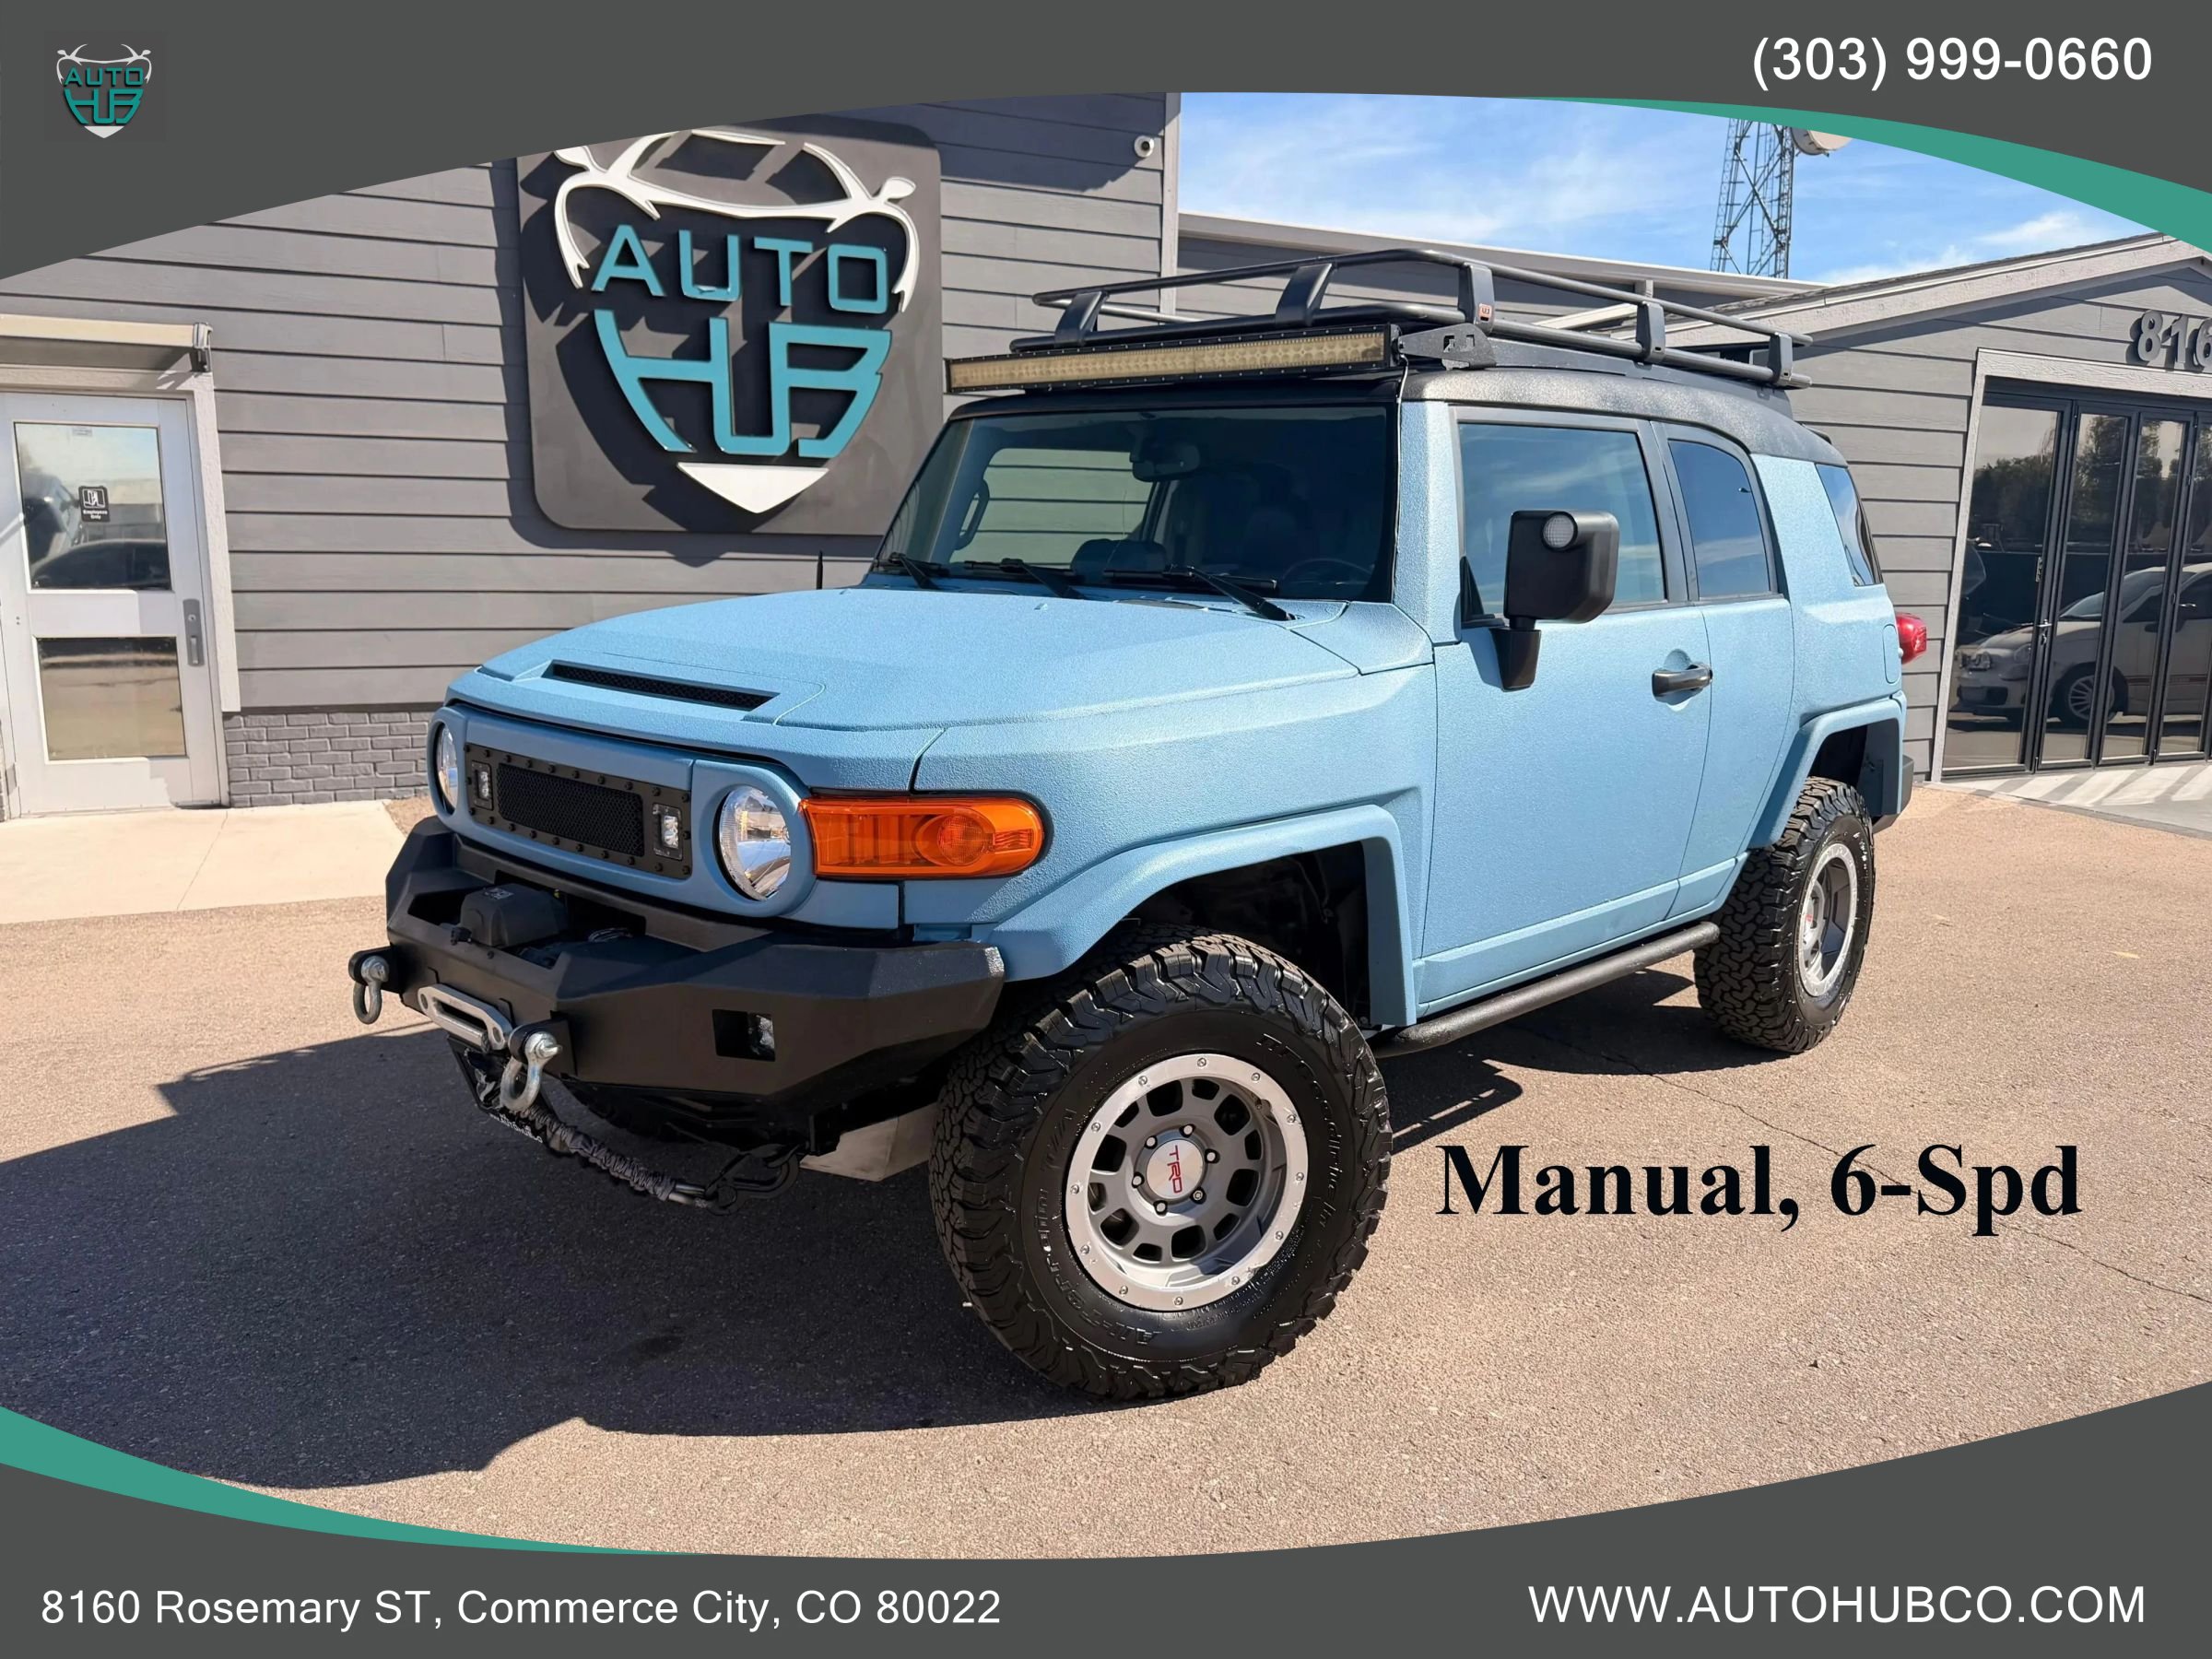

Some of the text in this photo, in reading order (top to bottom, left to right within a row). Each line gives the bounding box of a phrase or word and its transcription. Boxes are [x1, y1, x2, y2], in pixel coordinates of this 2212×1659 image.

[592, 225, 888, 314] AUTO
[594, 310, 892, 459] HUB
[1167, 1145, 1183, 1194] TRD
